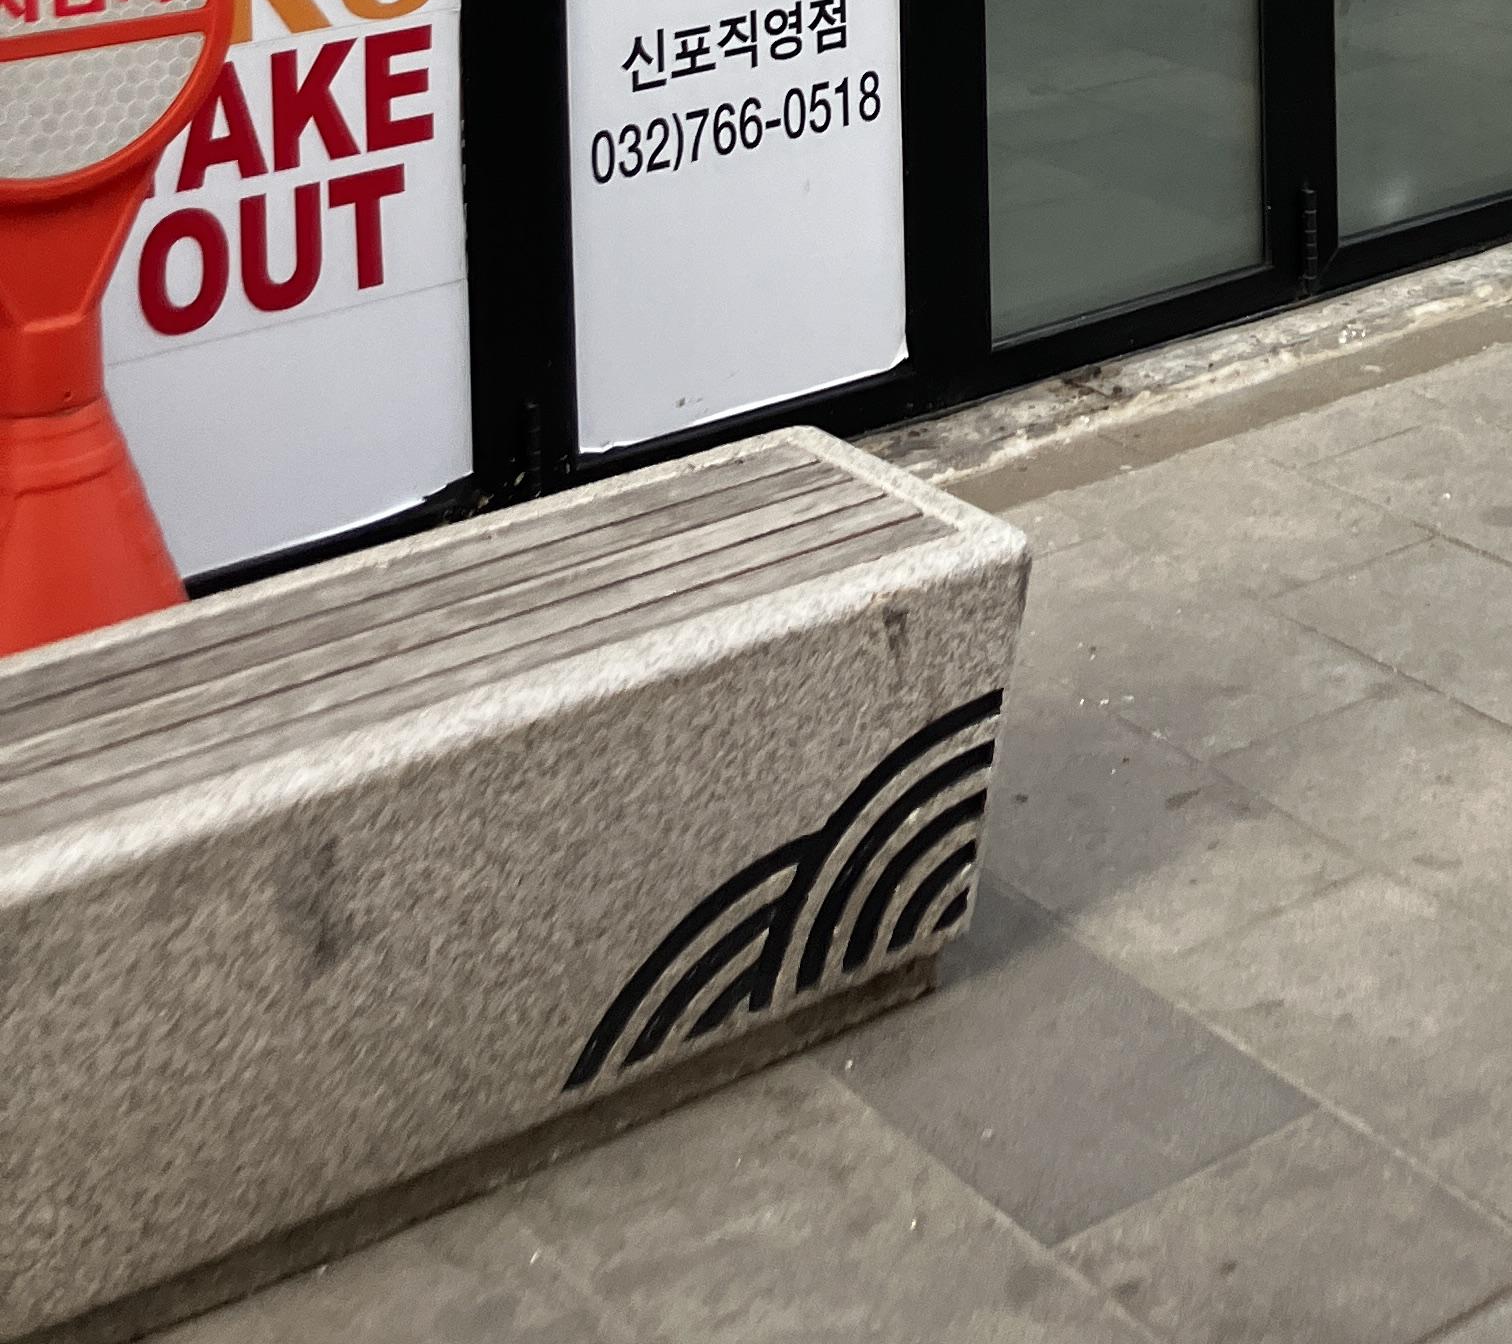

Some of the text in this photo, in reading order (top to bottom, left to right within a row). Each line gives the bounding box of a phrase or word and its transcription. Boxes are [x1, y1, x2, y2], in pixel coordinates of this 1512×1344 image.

[144, 24, 436, 200] AKE
[589, 69, 883, 185] 032)766-0518
[136, 163, 408, 337] OUT
